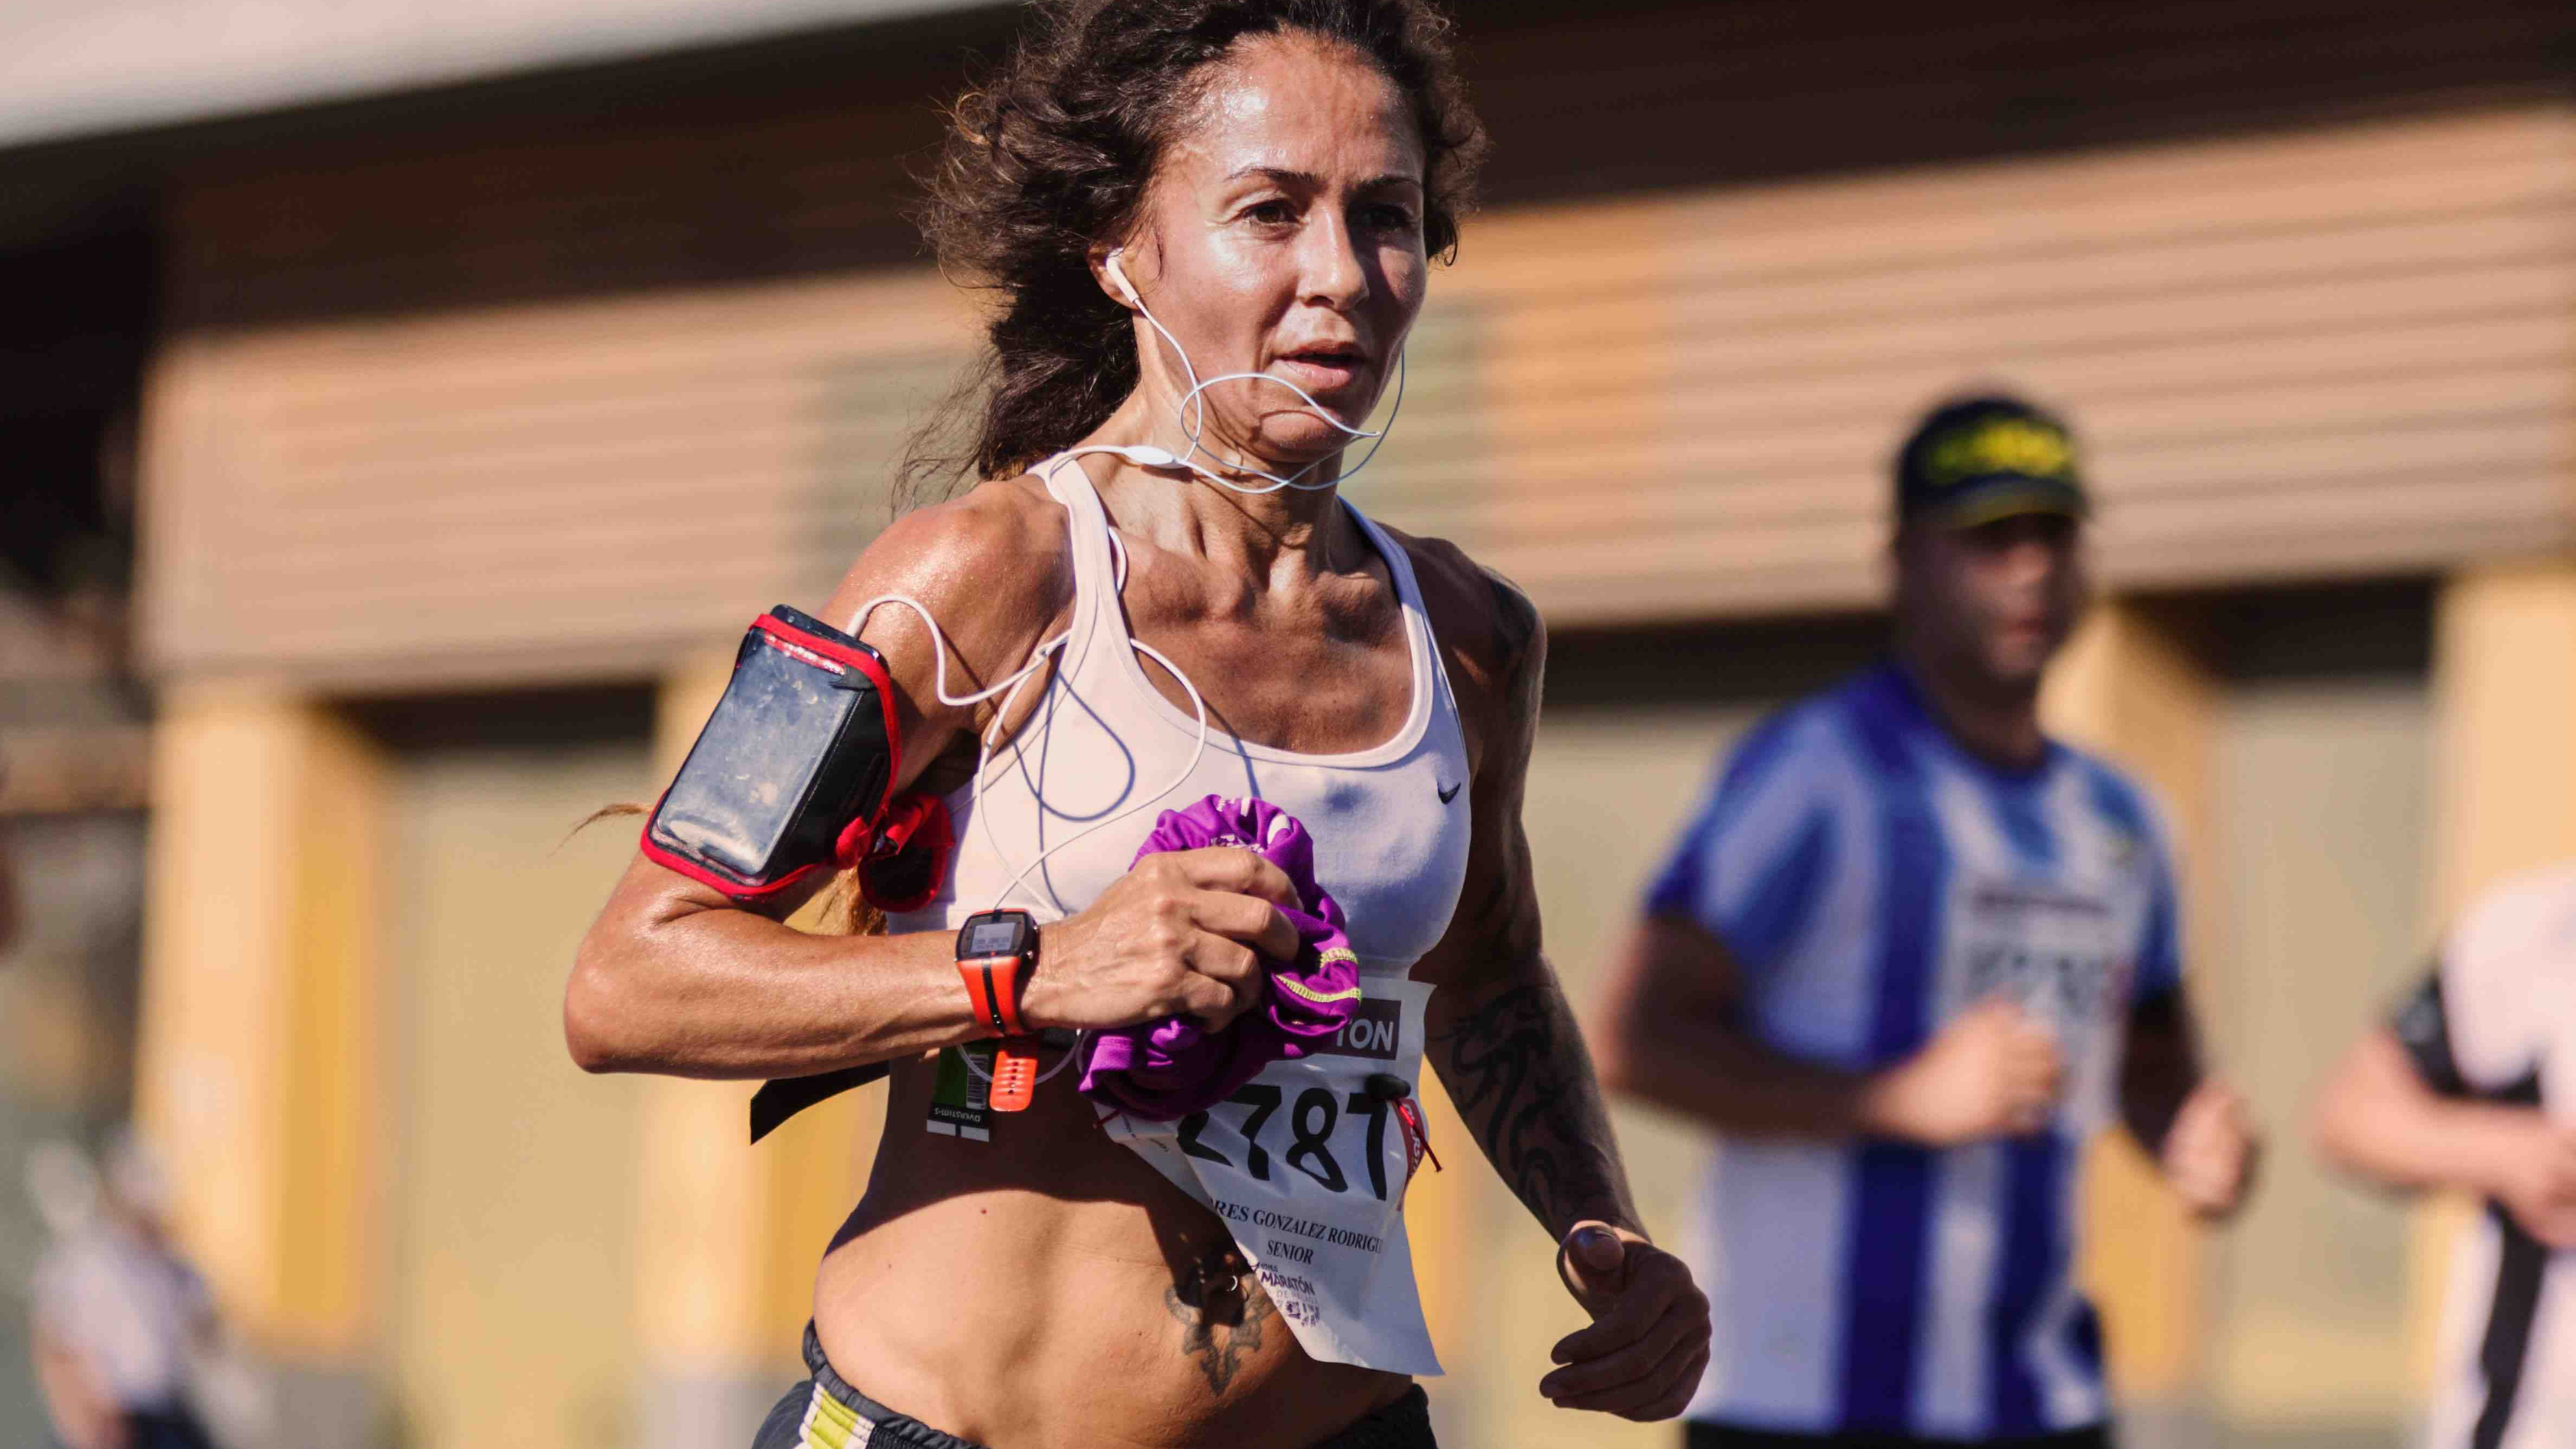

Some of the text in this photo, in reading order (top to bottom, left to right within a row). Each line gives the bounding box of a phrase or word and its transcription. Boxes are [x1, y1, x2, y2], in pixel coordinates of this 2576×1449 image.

[1177, 1085, 1387, 1201] 2787
[1209, 1197, 1249, 1221] RES
[1253, 1209, 1327, 1239] GONZALEZ
[1266, 1239, 1313, 1264] SENIOR
[1260, 1271, 1315, 1296] MARATÓN
